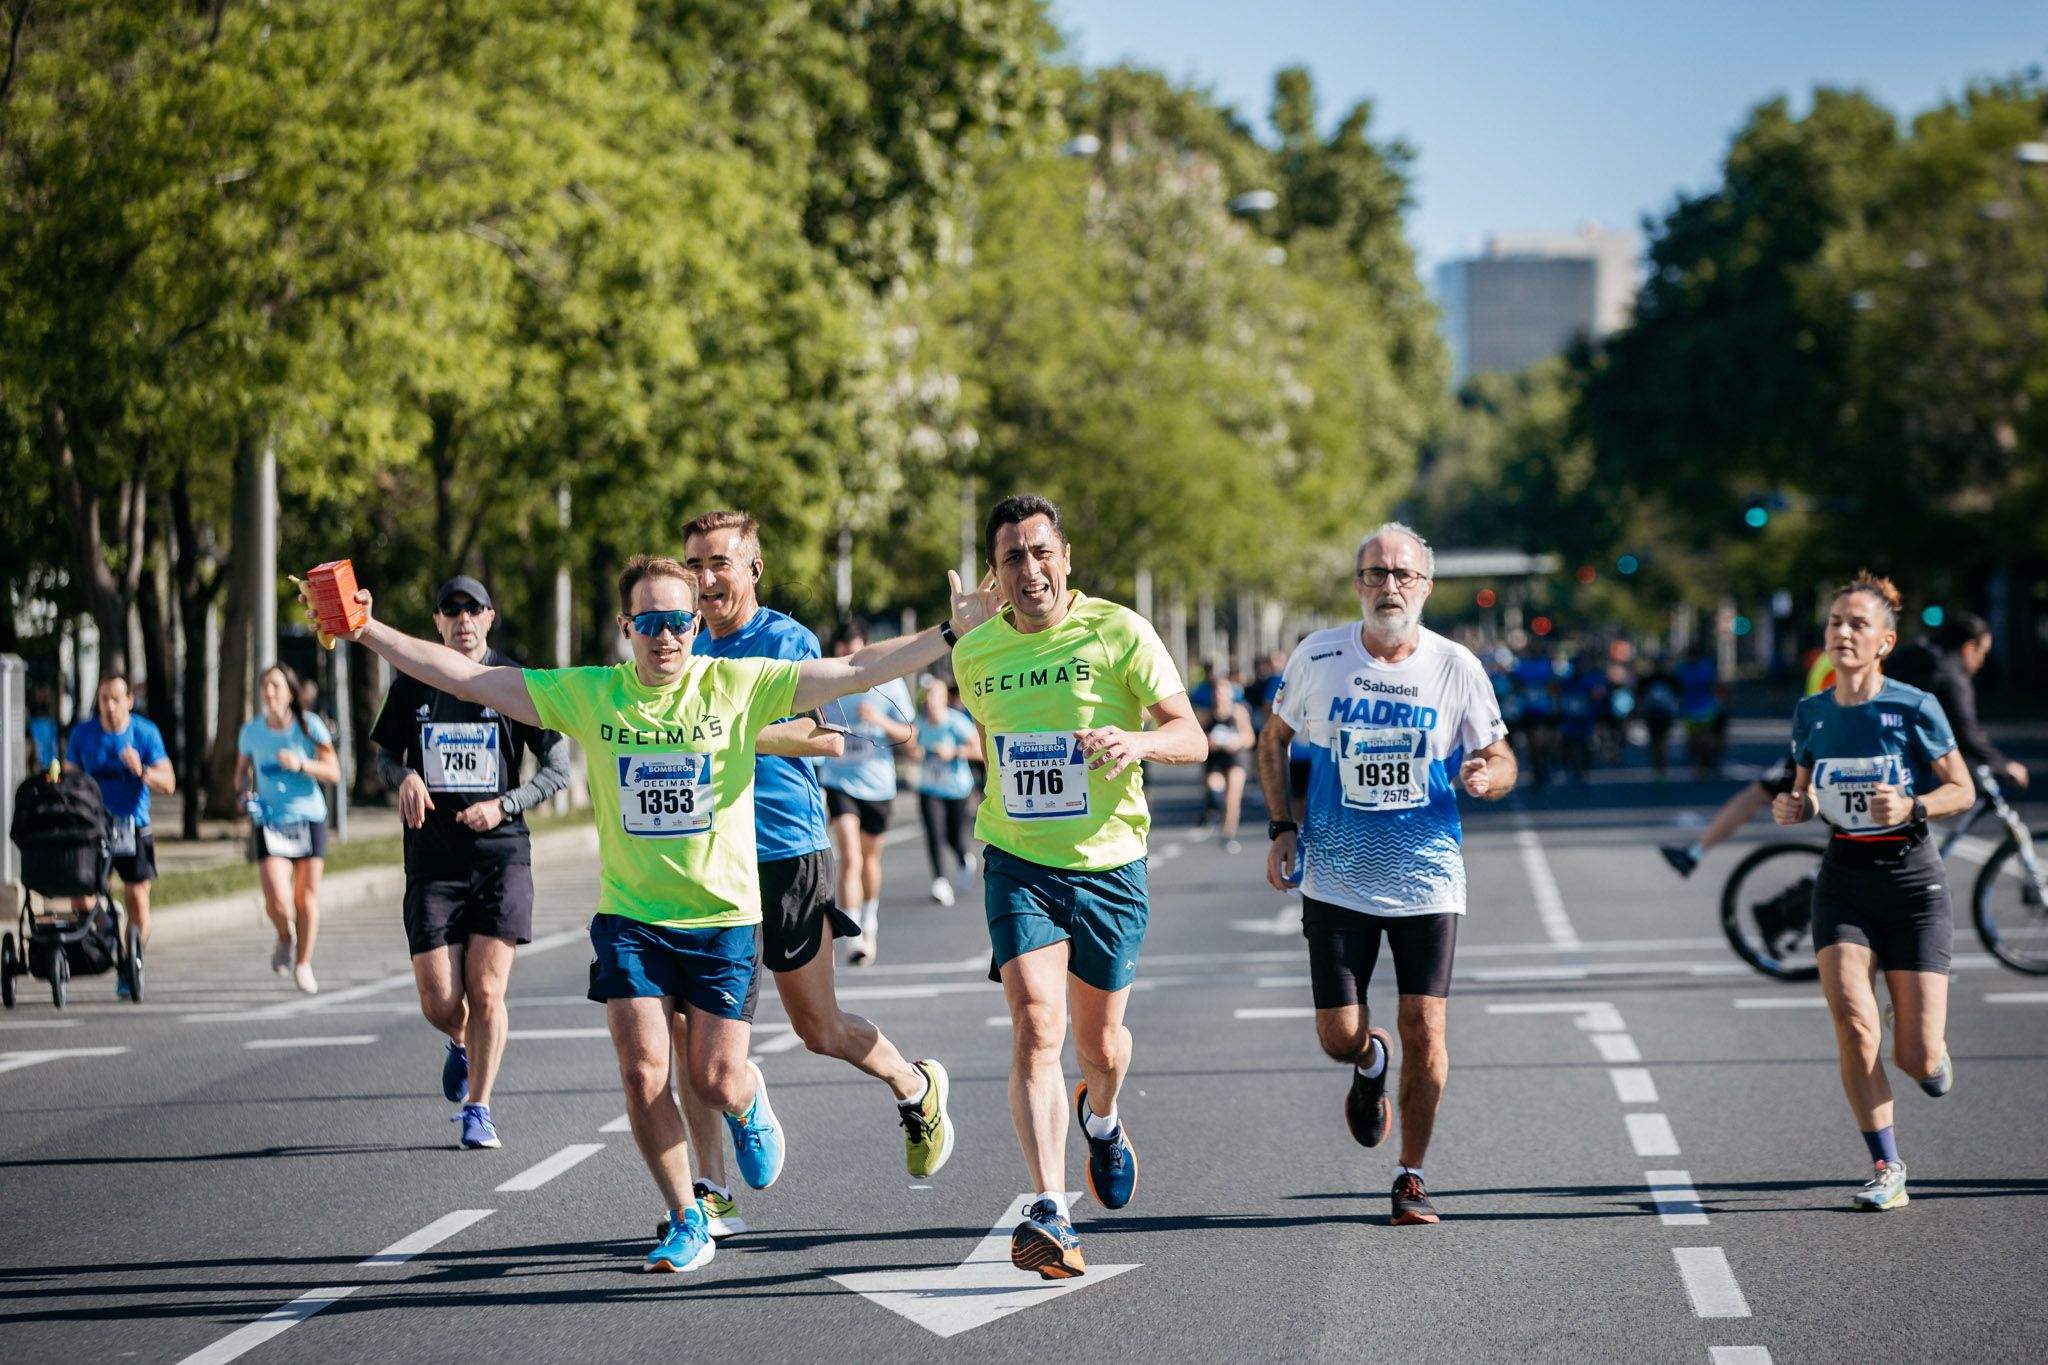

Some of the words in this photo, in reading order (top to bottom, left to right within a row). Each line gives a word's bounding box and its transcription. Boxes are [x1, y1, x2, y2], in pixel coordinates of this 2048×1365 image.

[1362, 679, 1418, 698] Sabadell
[1328, 697, 1438, 731] MADRID
[601, 719, 723, 745] DECIMAS
[1020, 744, 1065, 753] BOMBEROS
[442, 752, 477, 770] 736
[1015, 759, 1065, 768] DECIMAS
[1362, 754, 1410, 762] DECIMAS
[648, 765, 694, 773] BOMBEROS
[1354, 762, 1410, 787] 1938
[643, 779, 693, 788] DECIMAS
[1013, 768, 1064, 796] 1716
[636, 788, 695, 815] 1353
[1383, 789, 1410, 803] 2579
